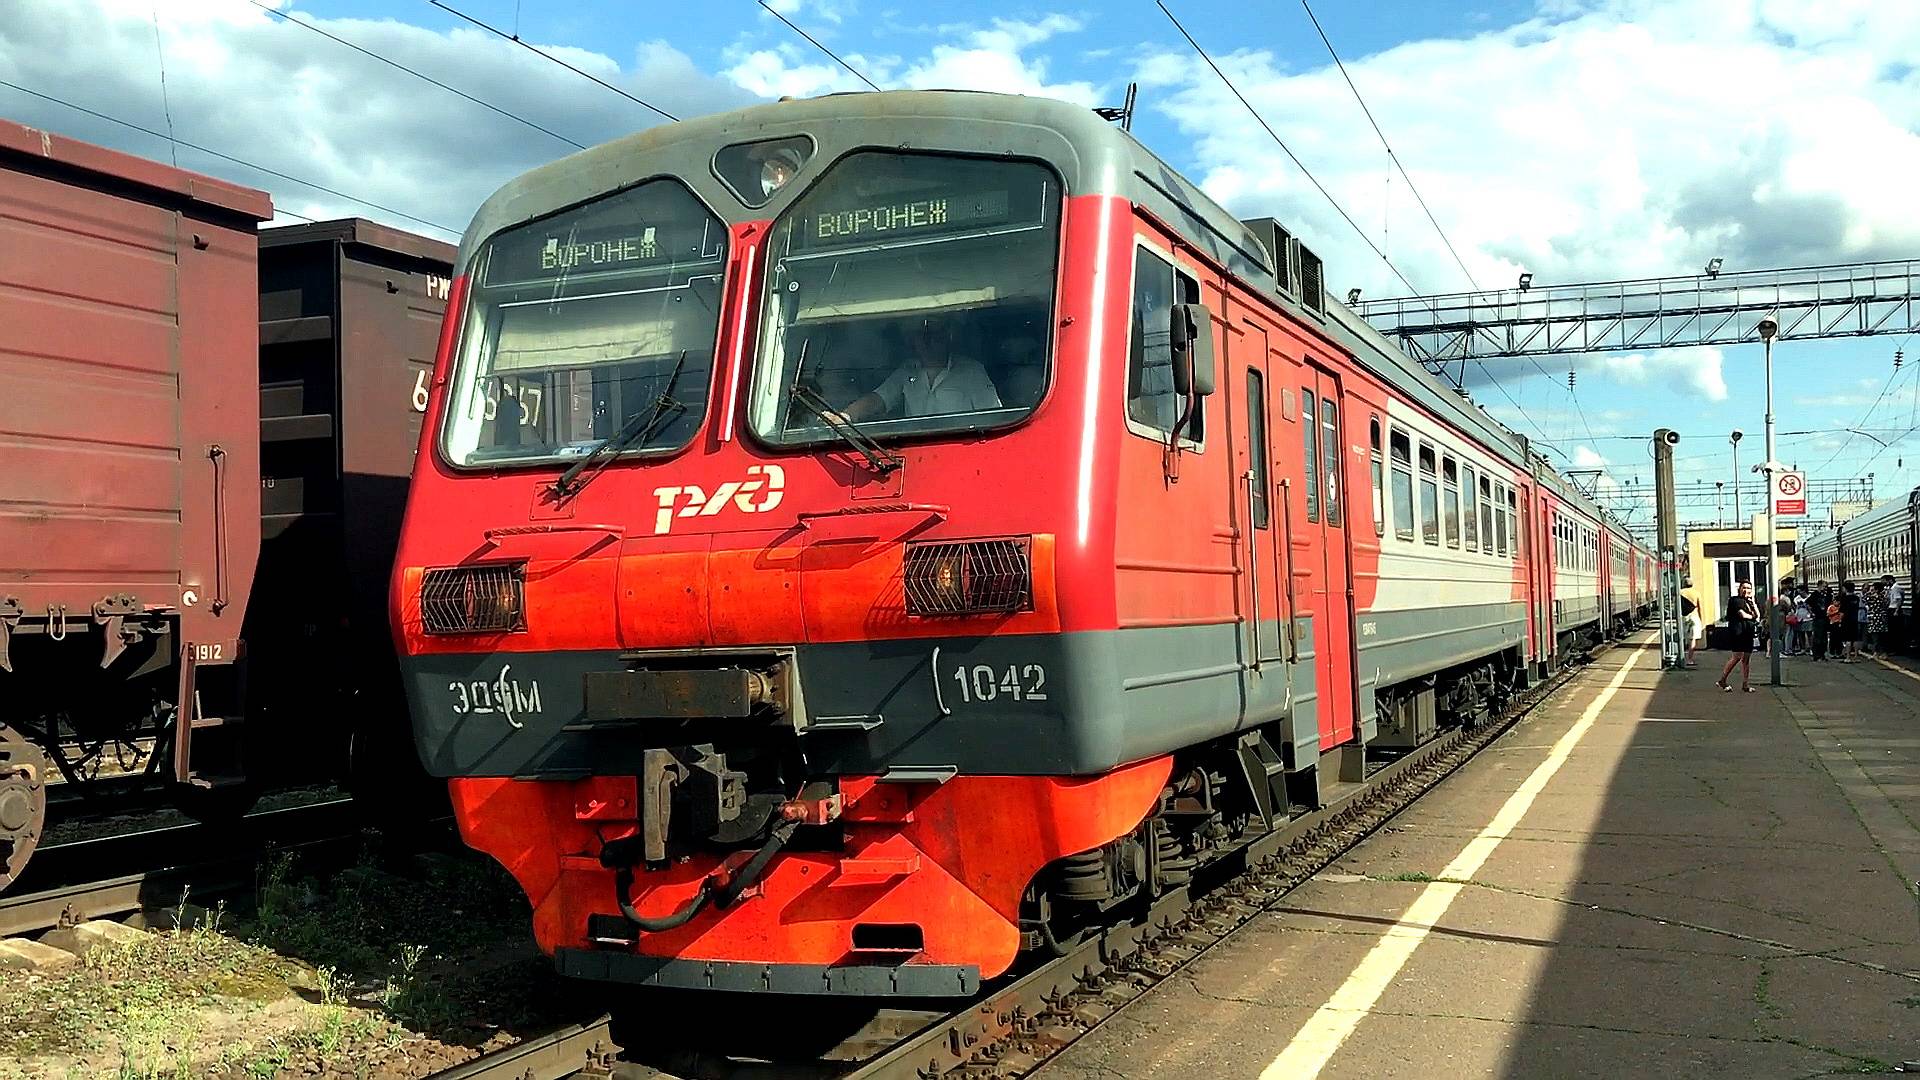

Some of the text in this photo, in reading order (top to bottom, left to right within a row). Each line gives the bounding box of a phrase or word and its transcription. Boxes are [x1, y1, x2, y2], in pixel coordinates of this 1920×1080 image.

[818, 200, 946, 238] ВОРОНЕЖ
[543, 235, 656, 269] ВОРОНЕЖ
[426, 274, 451, 300] РЖ
[190, 644, 222, 660] 1912
[954, 664, 1048, 702] 1042
